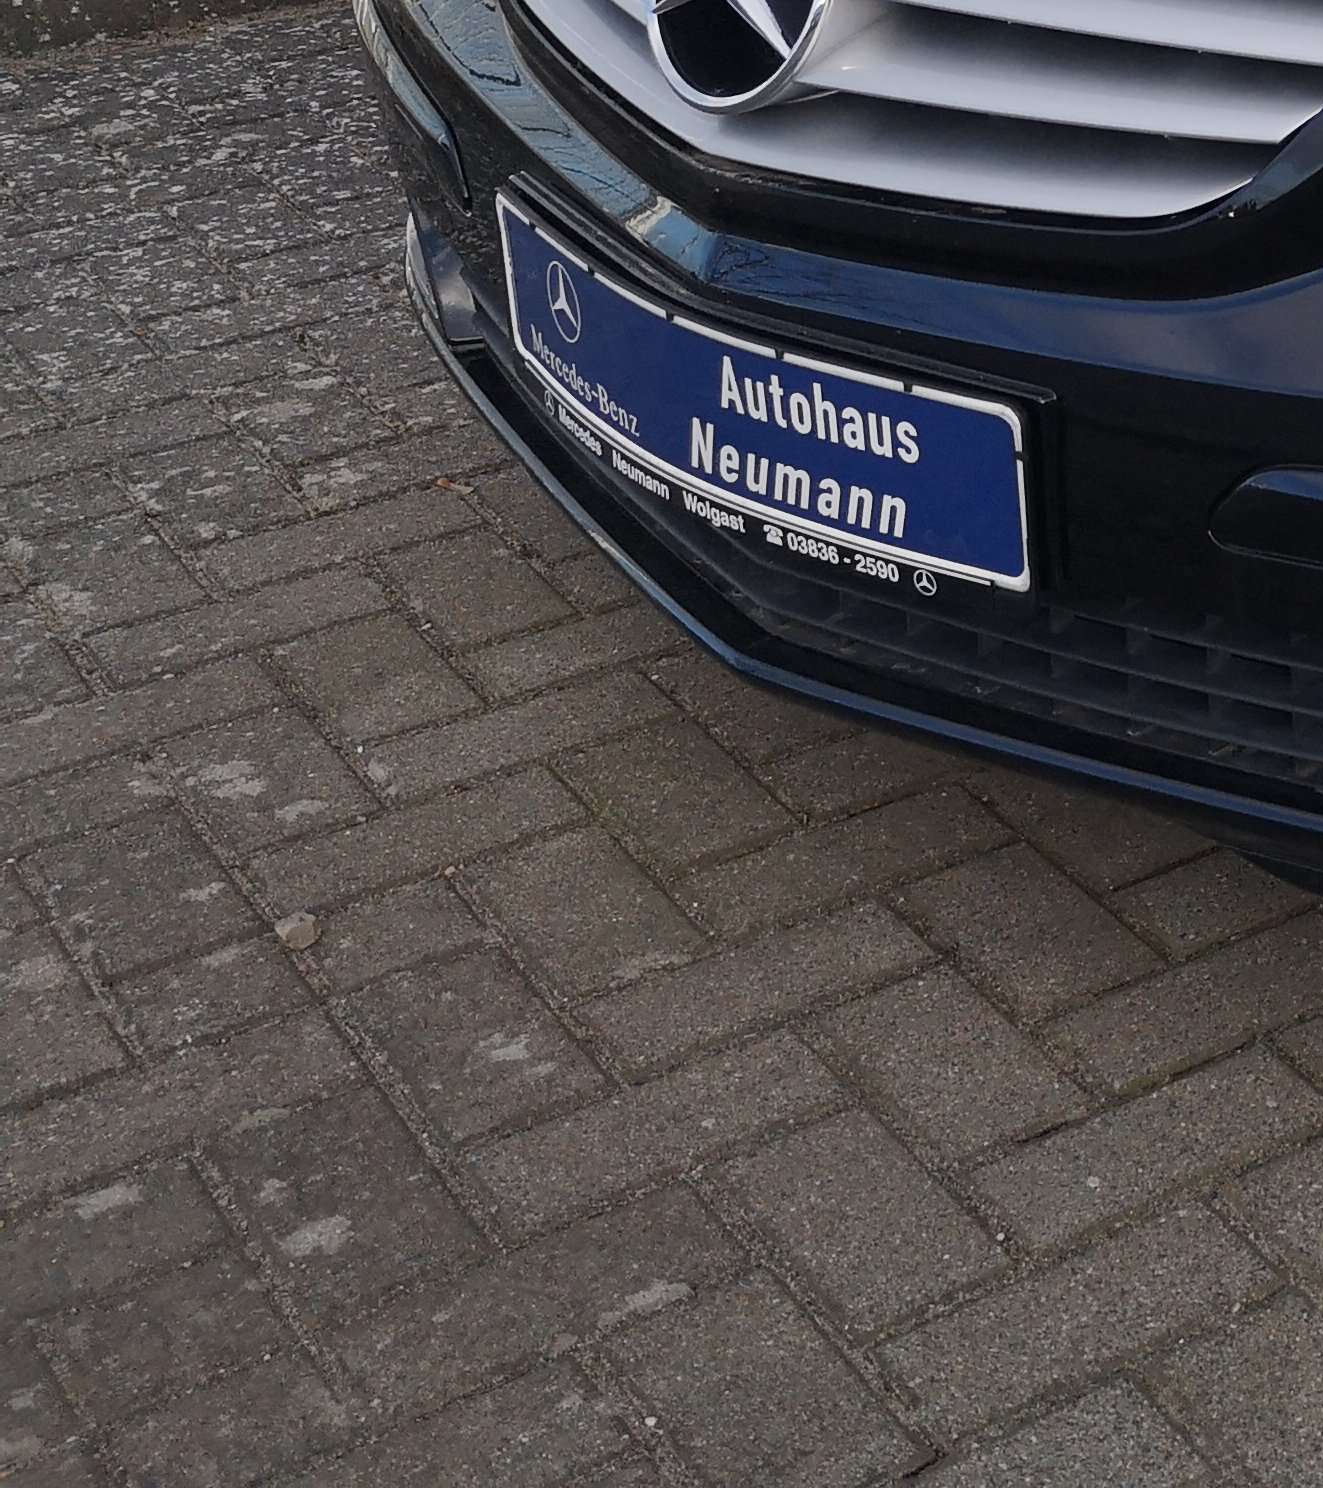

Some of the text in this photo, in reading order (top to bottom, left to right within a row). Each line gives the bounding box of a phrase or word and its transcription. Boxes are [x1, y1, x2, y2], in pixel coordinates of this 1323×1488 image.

[530, 323, 640, 437] Mercedes-Benz
[720, 355, 920, 463] Autohaus
[558, 404, 603, 456] Mercedes
[612, 449, 670, 500] Neumann
[682, 490, 746, 533] Wolgast
[787, 532, 839, 564] 03836
[855, 554, 899, 583] 2590
[690, 416, 907, 538] Neumann
